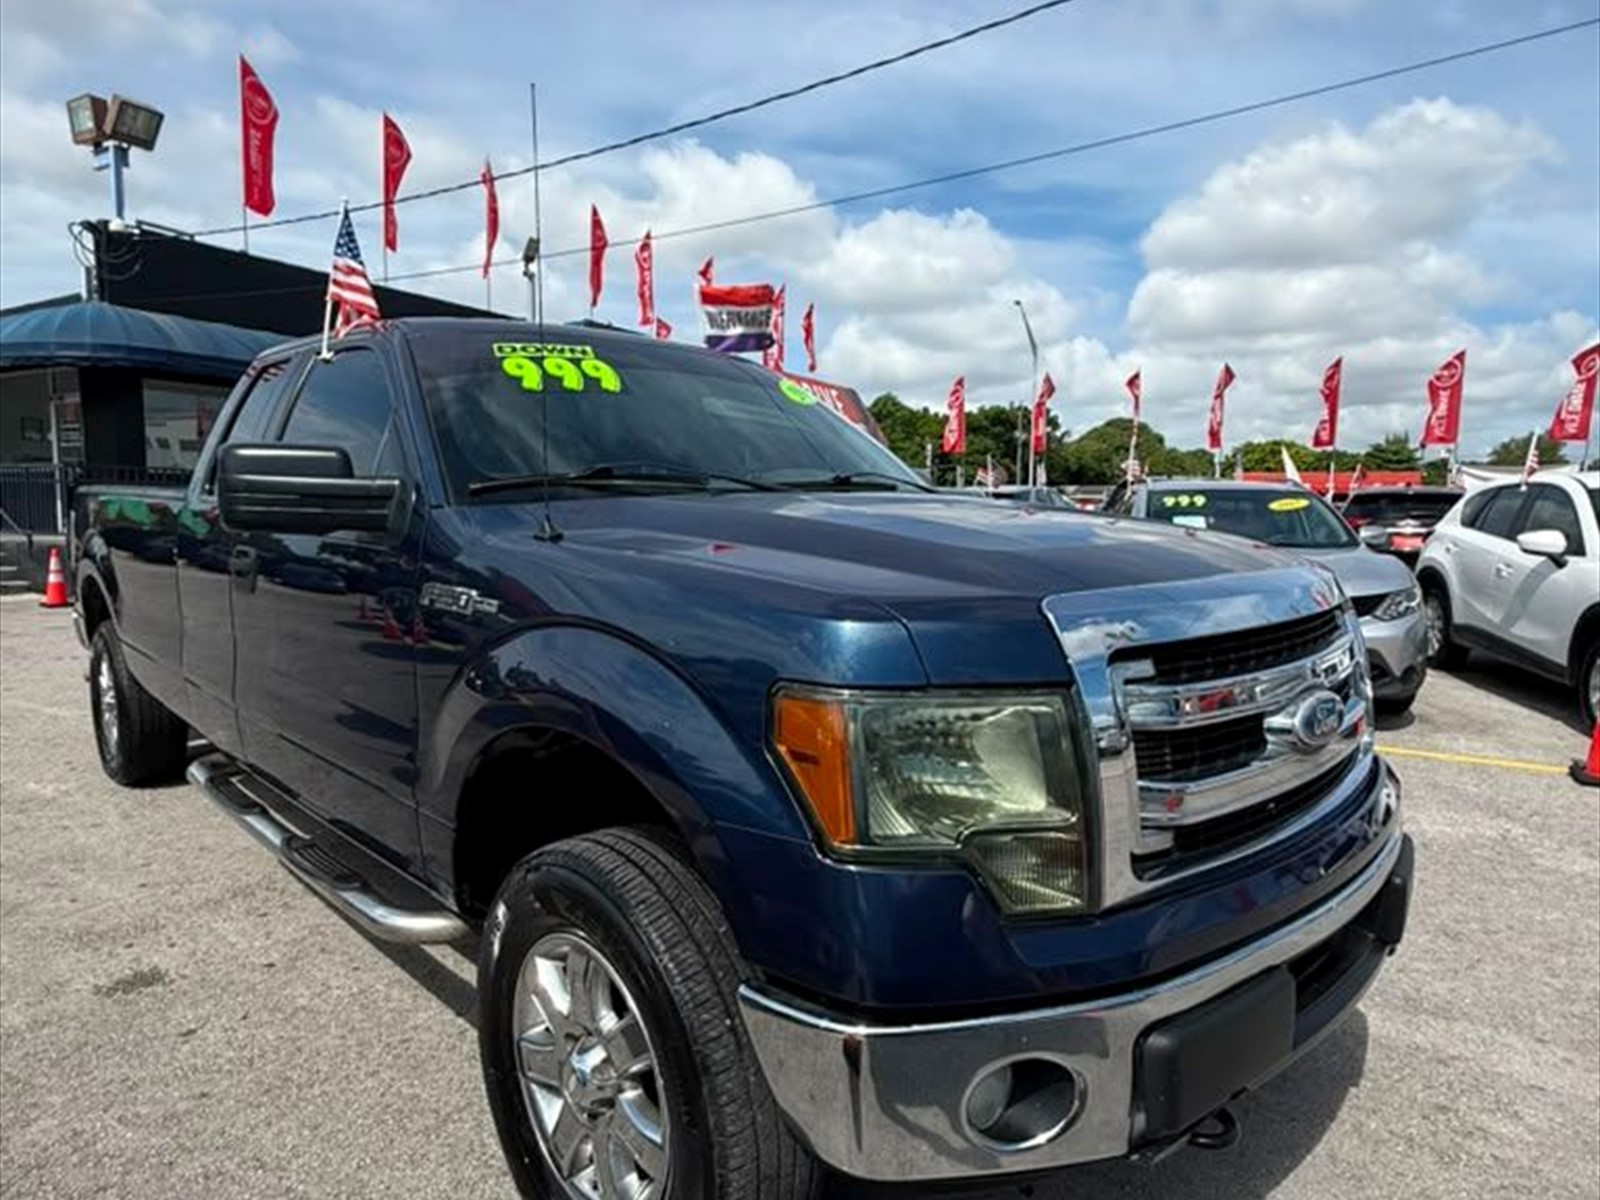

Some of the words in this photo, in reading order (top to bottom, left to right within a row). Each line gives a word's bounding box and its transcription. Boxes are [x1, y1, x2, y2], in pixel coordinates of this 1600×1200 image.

[497, 345, 589, 357] DOWN
[502, 356, 622, 394] 999
[1162, 494, 1207, 508] 999
